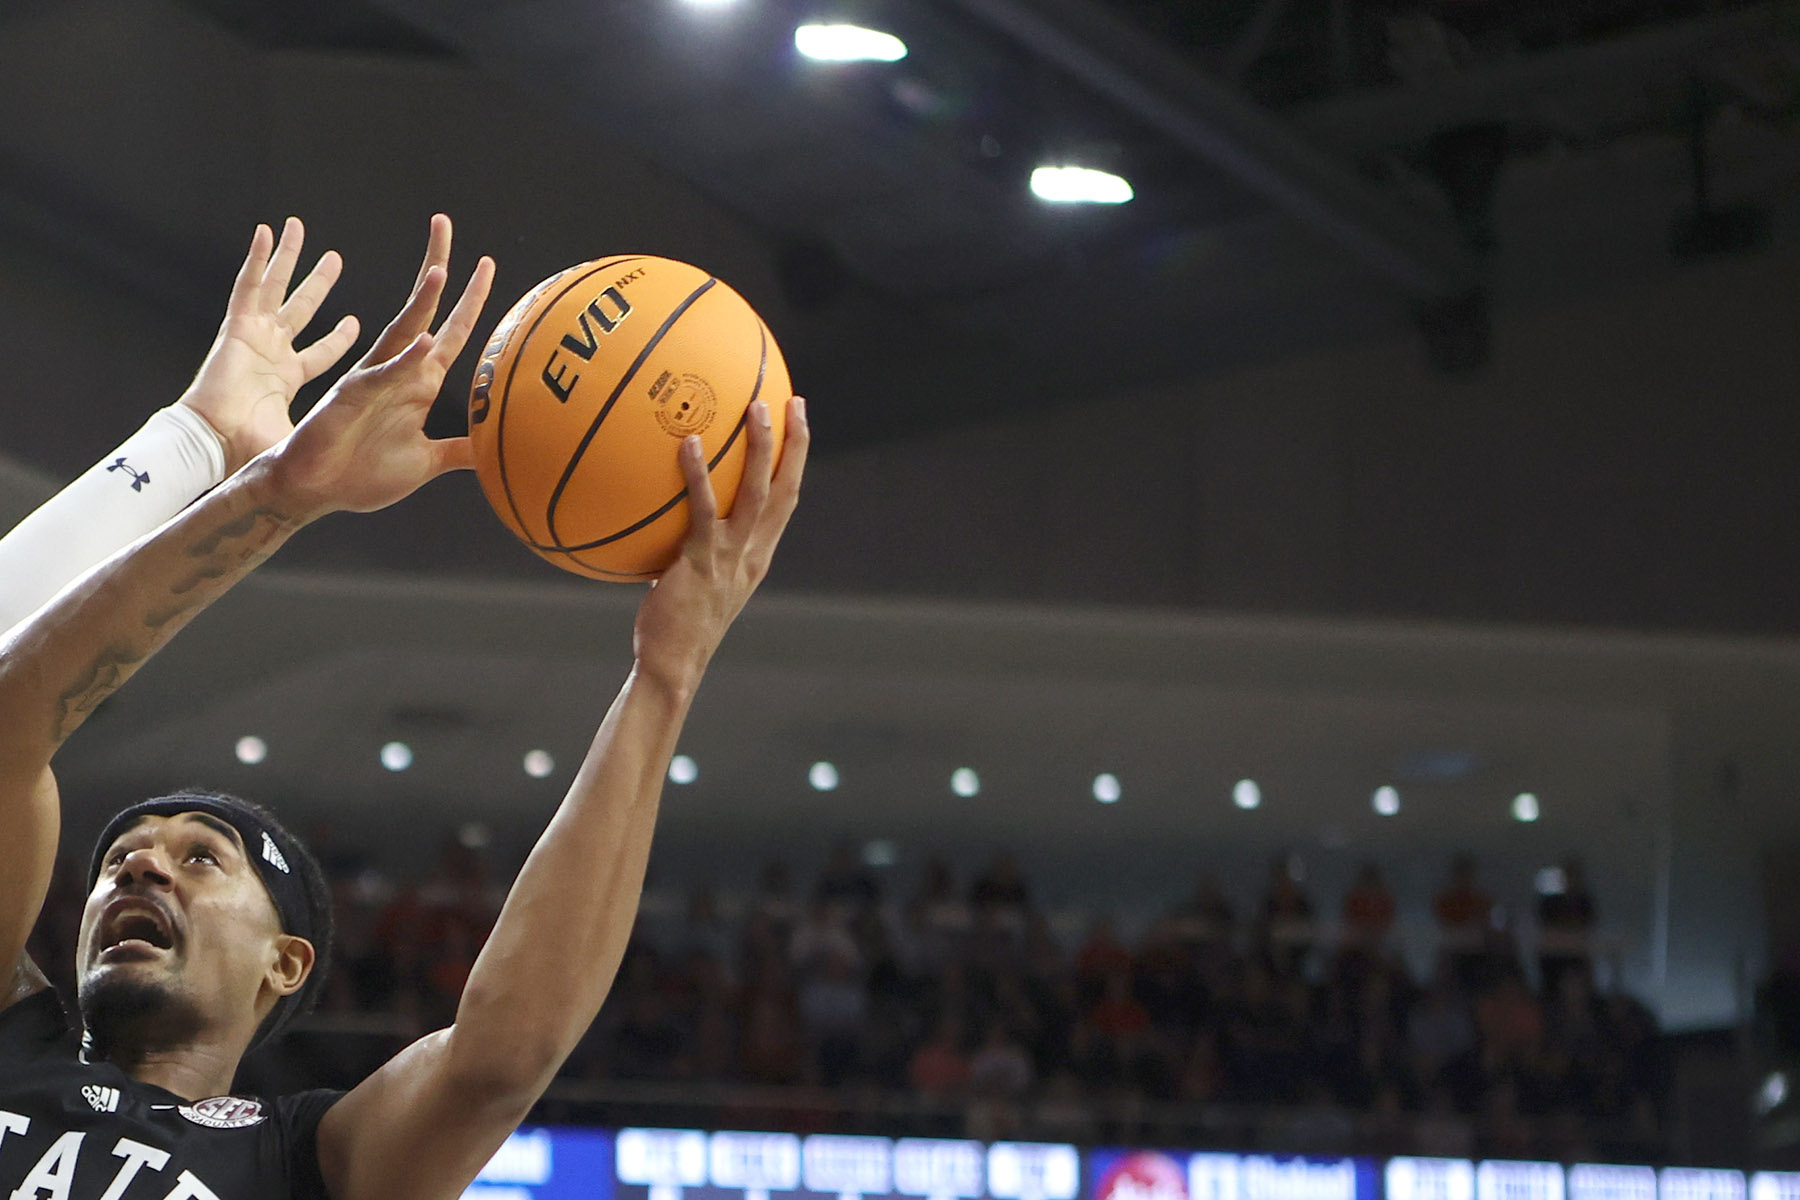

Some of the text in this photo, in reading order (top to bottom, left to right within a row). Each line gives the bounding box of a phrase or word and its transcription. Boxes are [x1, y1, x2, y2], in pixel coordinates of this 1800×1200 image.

[615, 267, 646, 289] NXT
[541, 286, 634, 404] EVO
[182, 1110, 248, 1129] GRADUATE
[199, 1099, 257, 1121] SEC
